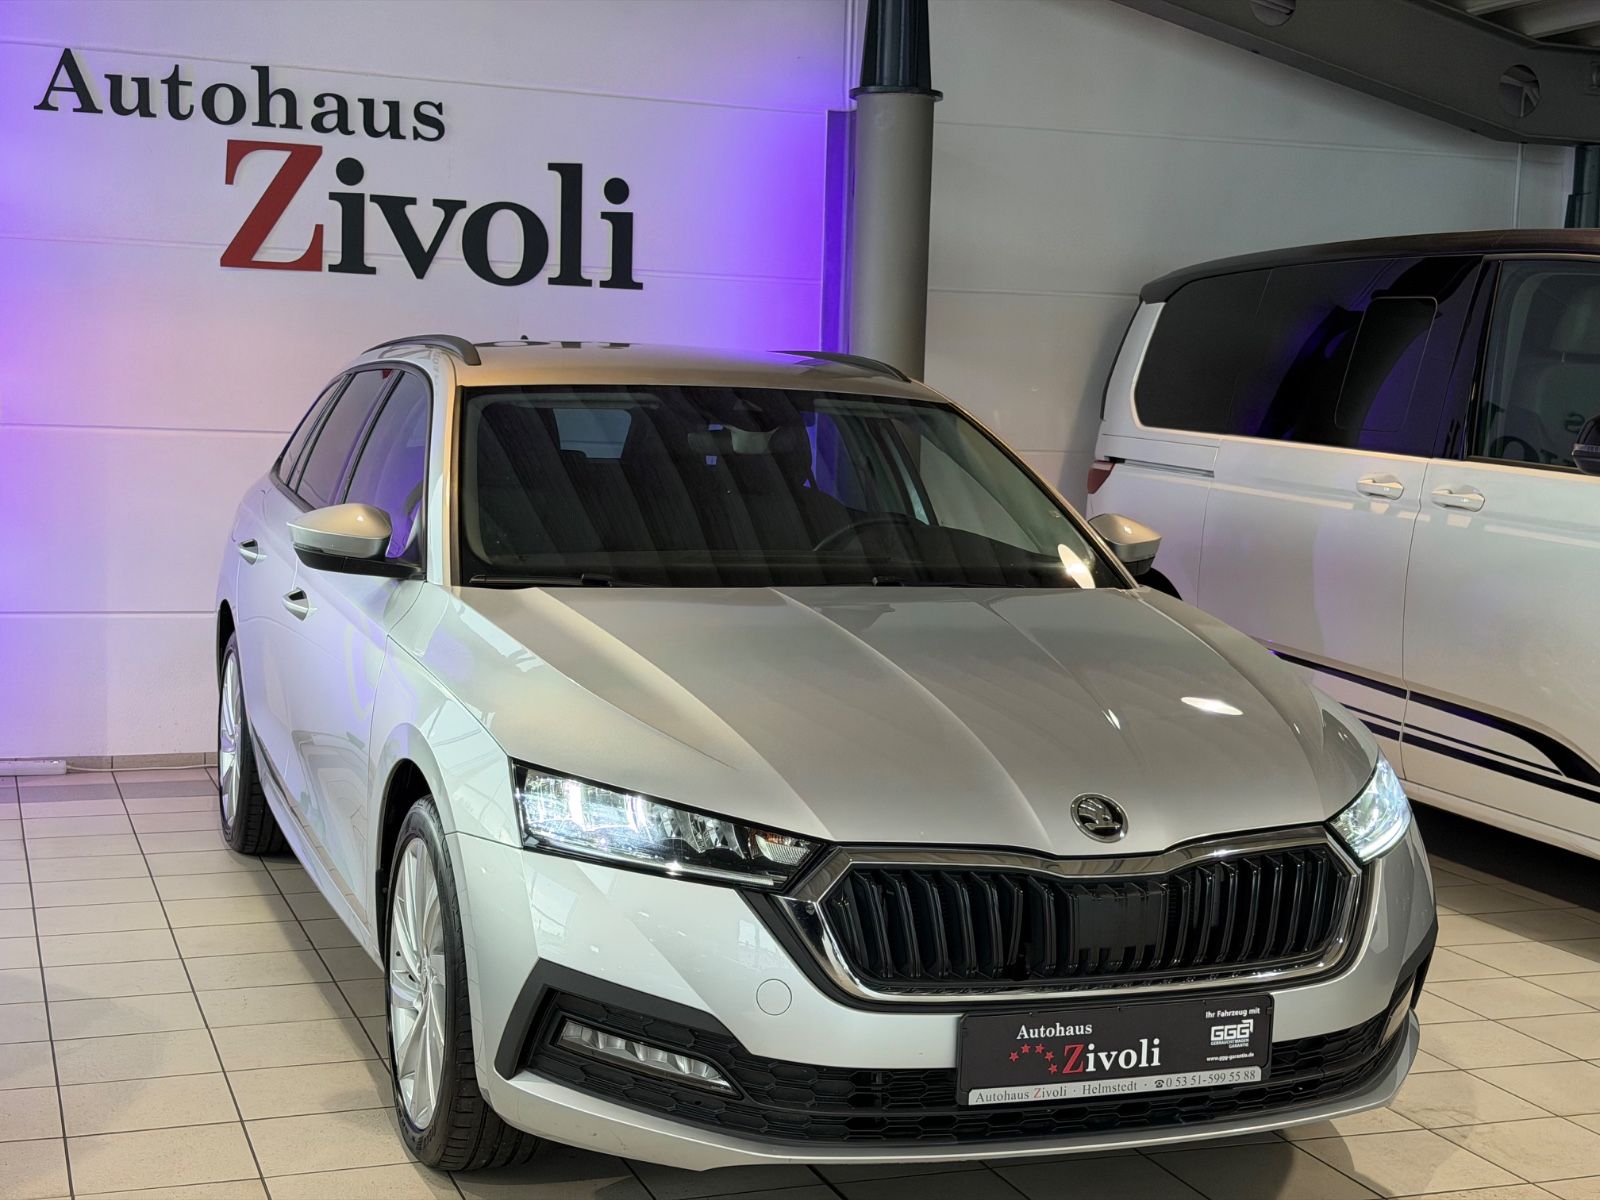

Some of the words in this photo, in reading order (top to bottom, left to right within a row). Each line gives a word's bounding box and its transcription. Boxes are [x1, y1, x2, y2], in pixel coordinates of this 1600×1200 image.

[34, 48, 446, 141] Autohaus
[220, 139, 643, 290] Zivoli
[1205, 1011, 1216, 1019] Ihr
[1216, 1009, 1248, 1017] Fahrzeug
[1248, 1007, 1261, 1015] mit
[1211, 1019, 1254, 1041] GGG
[1016, 1022, 1093, 1040] Autohaus
[1062, 1038, 1161, 1074] Zivoli
[975, 1090, 1030, 1103] Autohaus
[1033, 1085, 1068, 1099] Zivoli
[1082, 1080, 1138, 1095] Helmstedt
[1228, 1071, 1242, 1082] 55
[1243, 1069, 1257, 1081] 88
